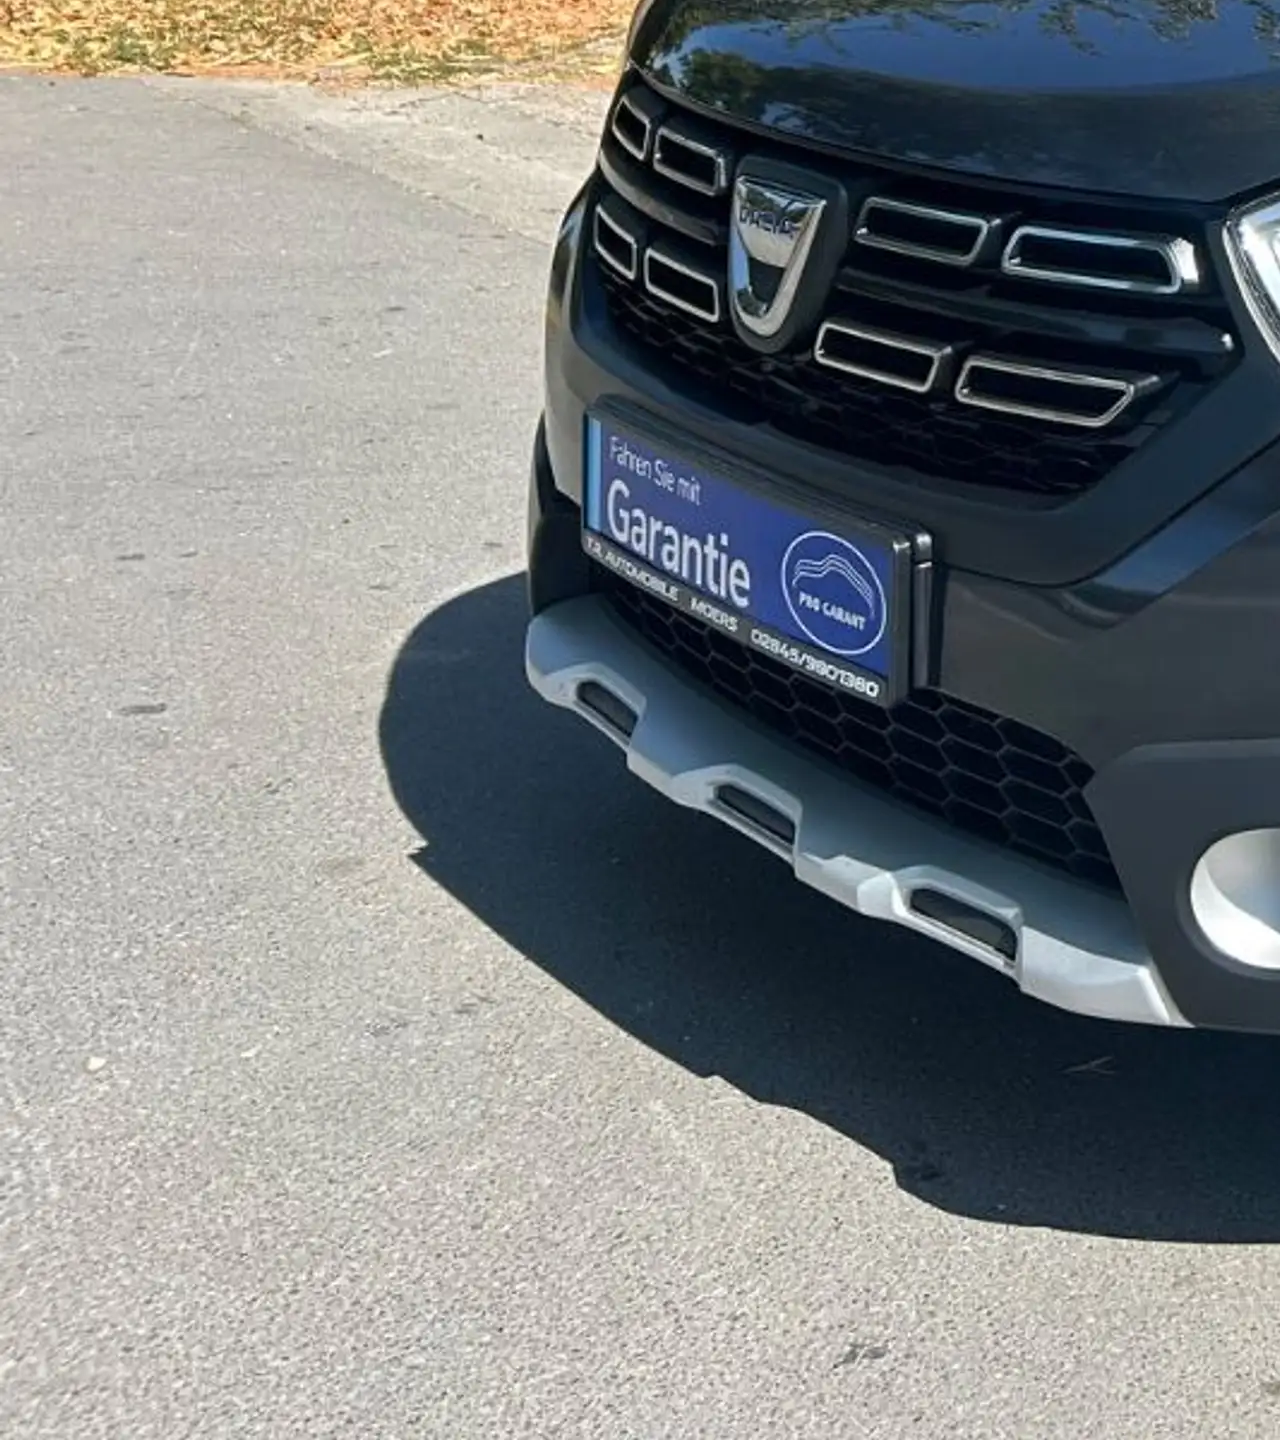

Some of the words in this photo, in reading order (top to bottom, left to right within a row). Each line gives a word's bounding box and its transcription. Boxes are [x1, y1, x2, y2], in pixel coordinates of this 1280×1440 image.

[608, 435, 652, 478] Fahren
[653, 459, 676, 493] Sie
[676, 475, 702, 507] mit
[605, 551, 679, 602] AUTOMOBILE
[606, 478, 751, 608] Garantie
